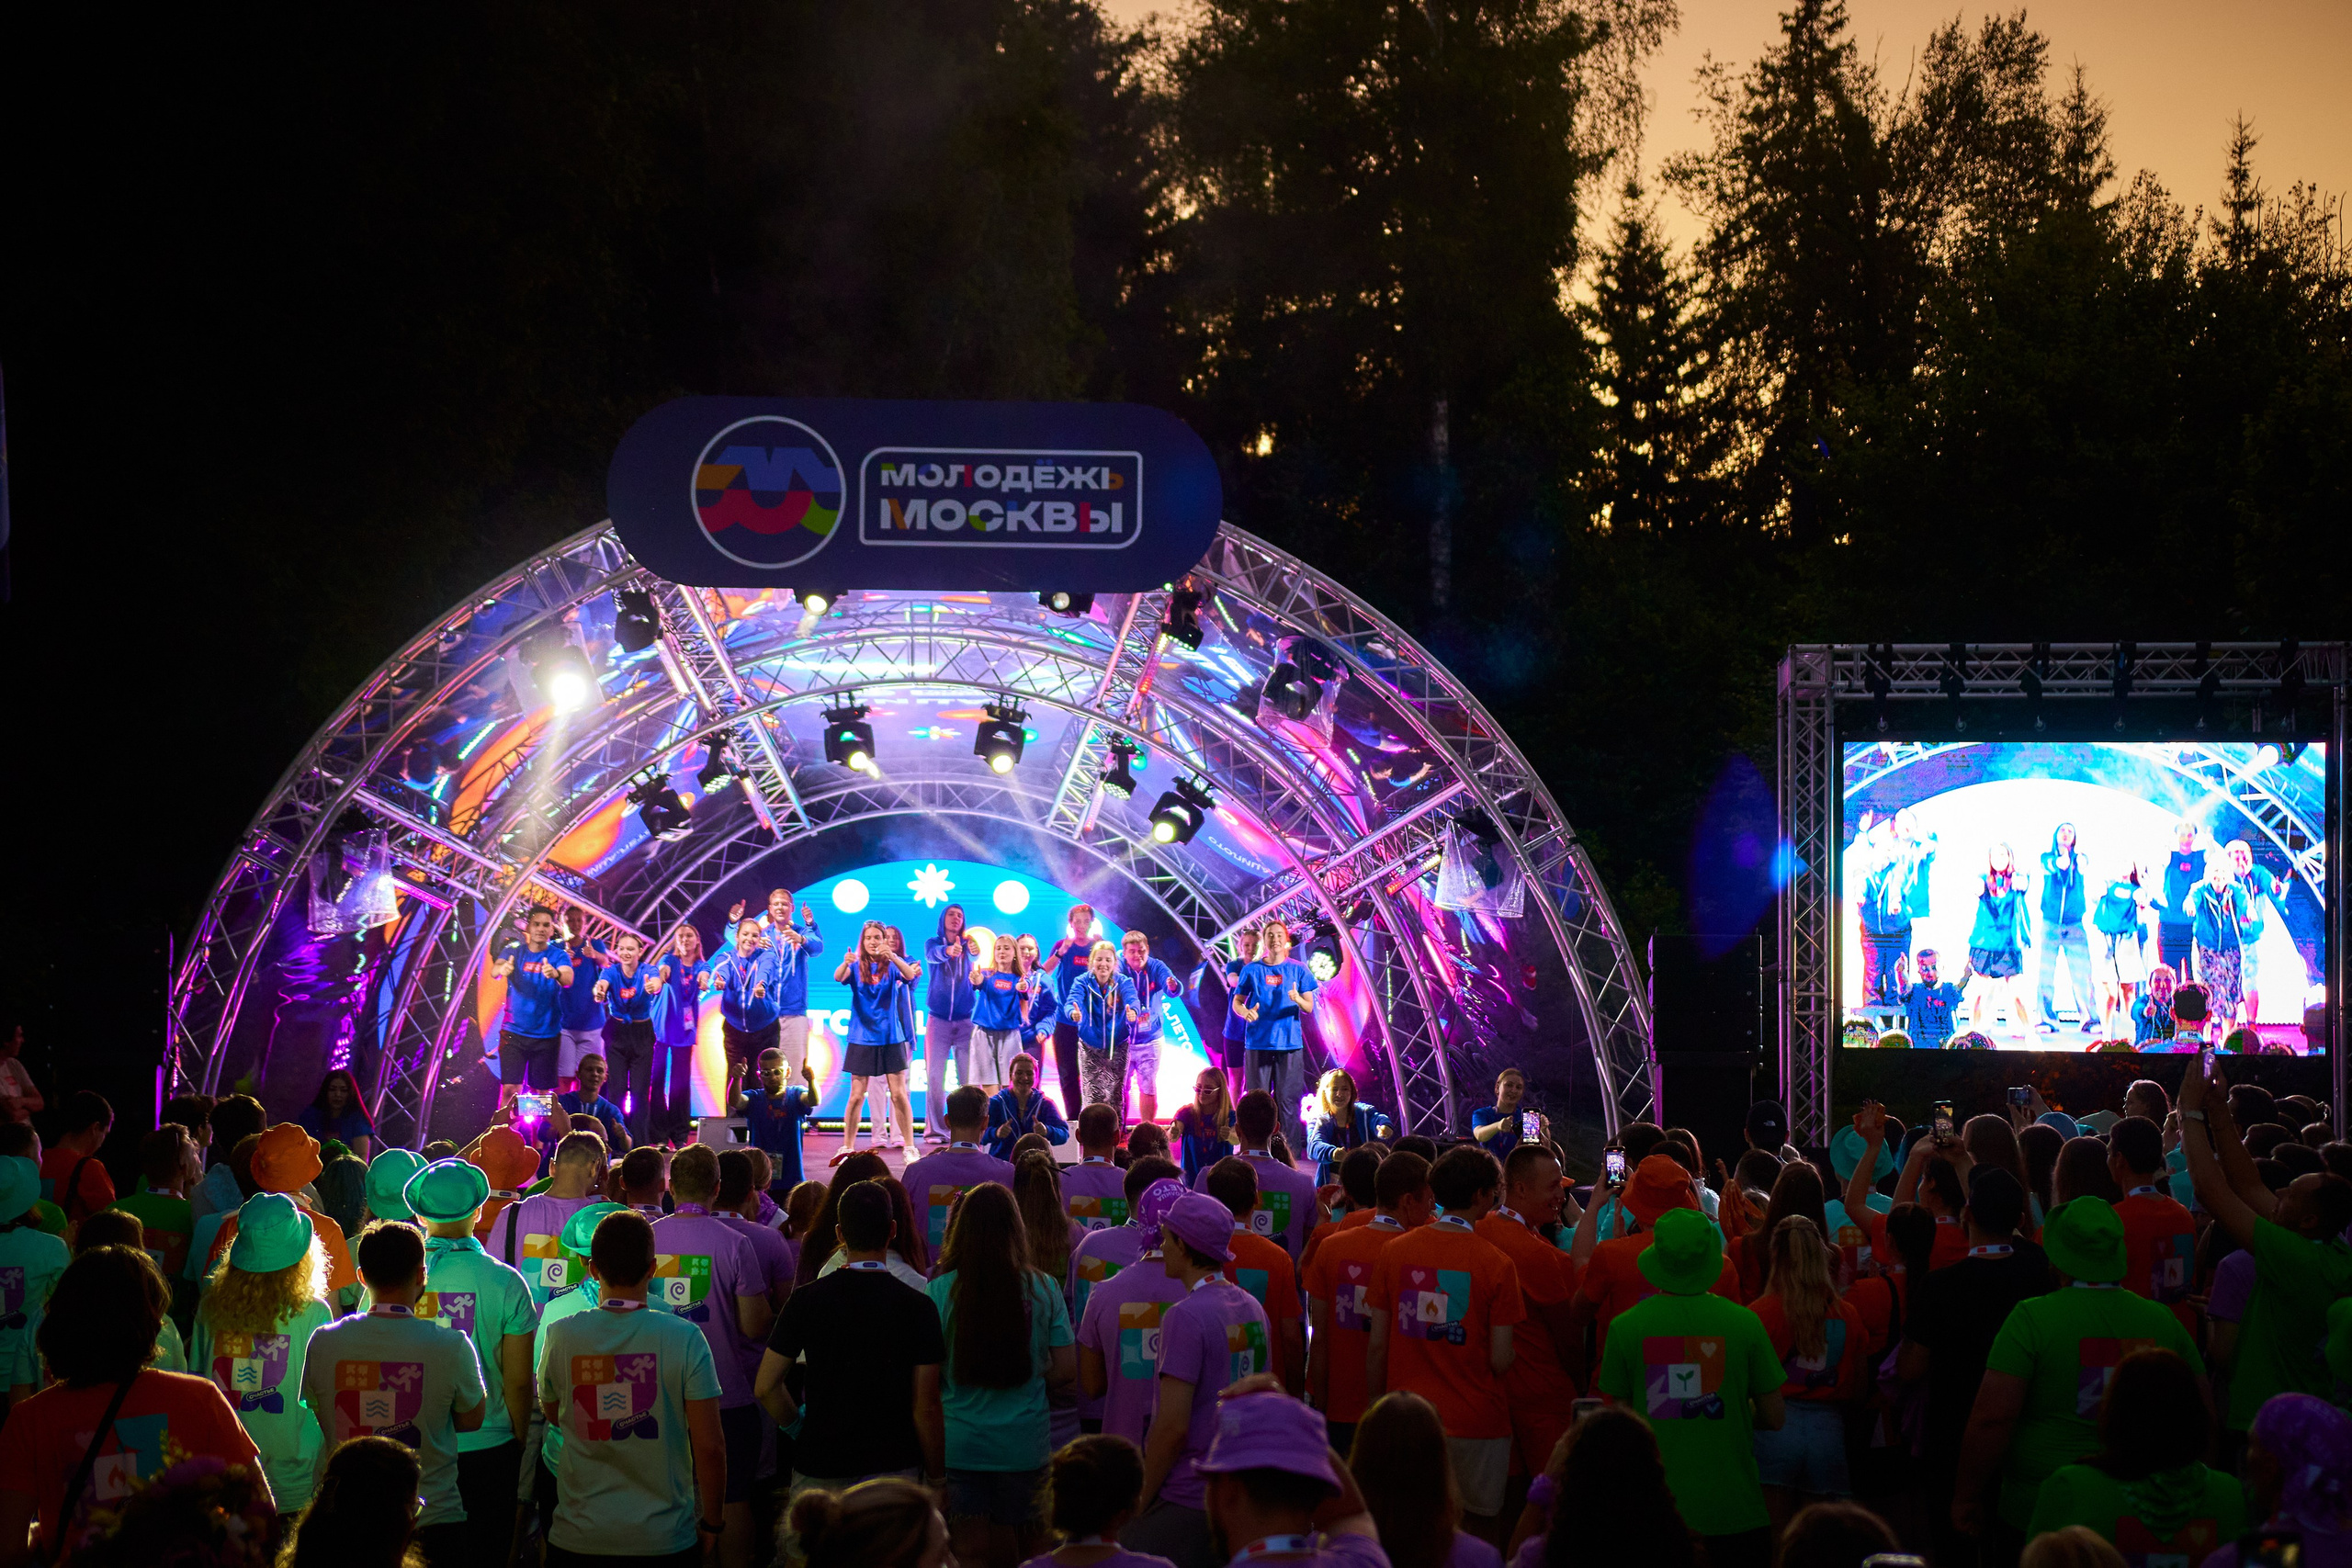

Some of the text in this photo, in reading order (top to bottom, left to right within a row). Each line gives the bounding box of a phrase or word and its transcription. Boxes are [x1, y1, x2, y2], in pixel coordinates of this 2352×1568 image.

[880, 459, 1125, 494] МОЛОДЁЖЬ
[880, 498, 1123, 534] МОСКВЫ
[555, 1283, 578, 1295] СЧАСТЬЕ
[679, 1300, 702, 1313] СЧАСТЬЕ
[248, 1388, 275, 1400] СЧАСТЬЕ
[618, 1411, 648, 1427] СЧАСТЬЕ
[380, 1420, 411, 1435] СЧАСТЬЕ
